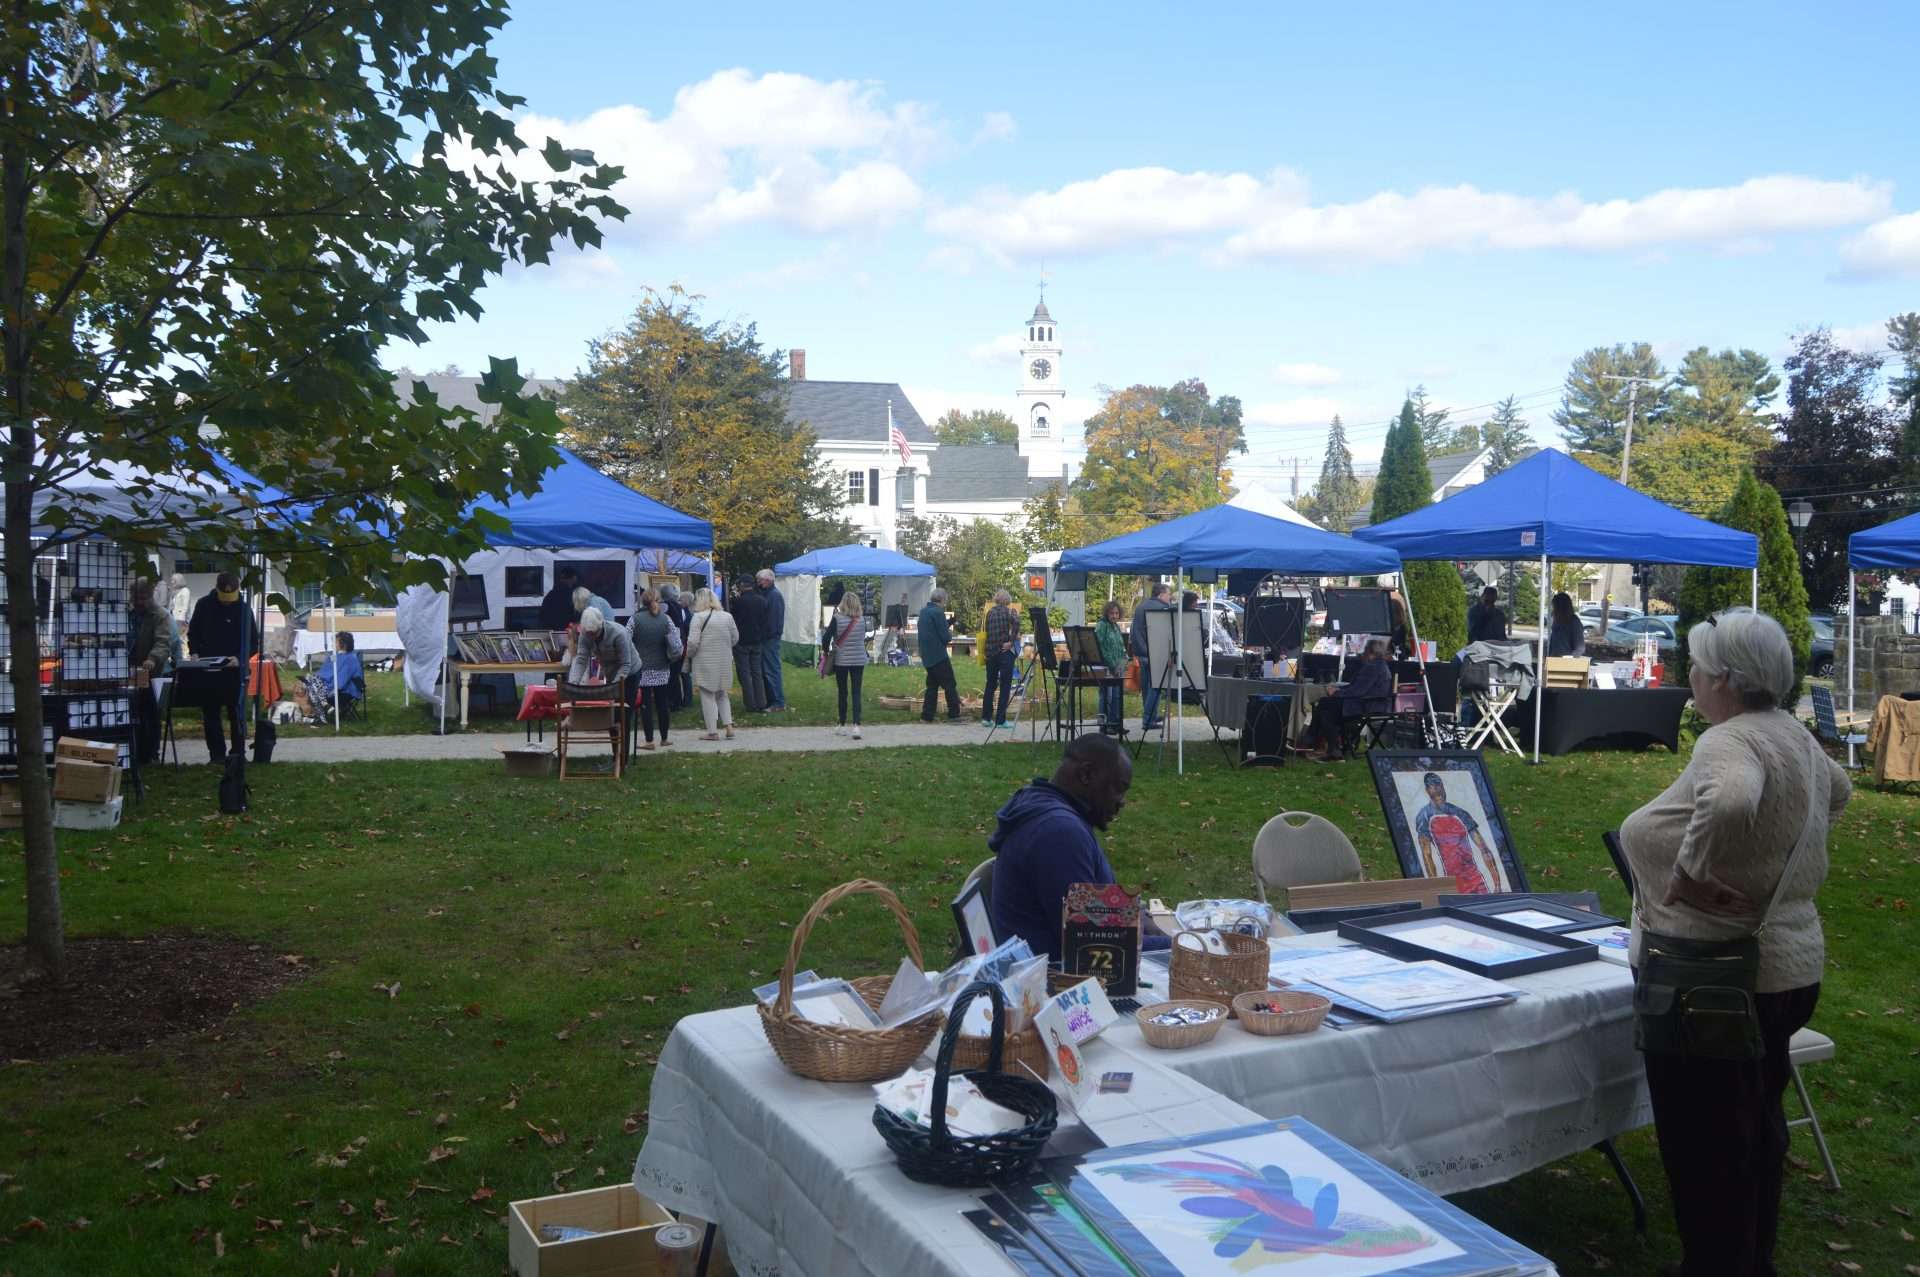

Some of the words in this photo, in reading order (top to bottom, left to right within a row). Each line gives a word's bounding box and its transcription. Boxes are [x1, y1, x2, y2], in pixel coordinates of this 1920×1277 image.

[71, 750, 97, 759] BLICK
[1089, 950, 1113, 969] 72
[1055, 989, 1080, 1012] ART
